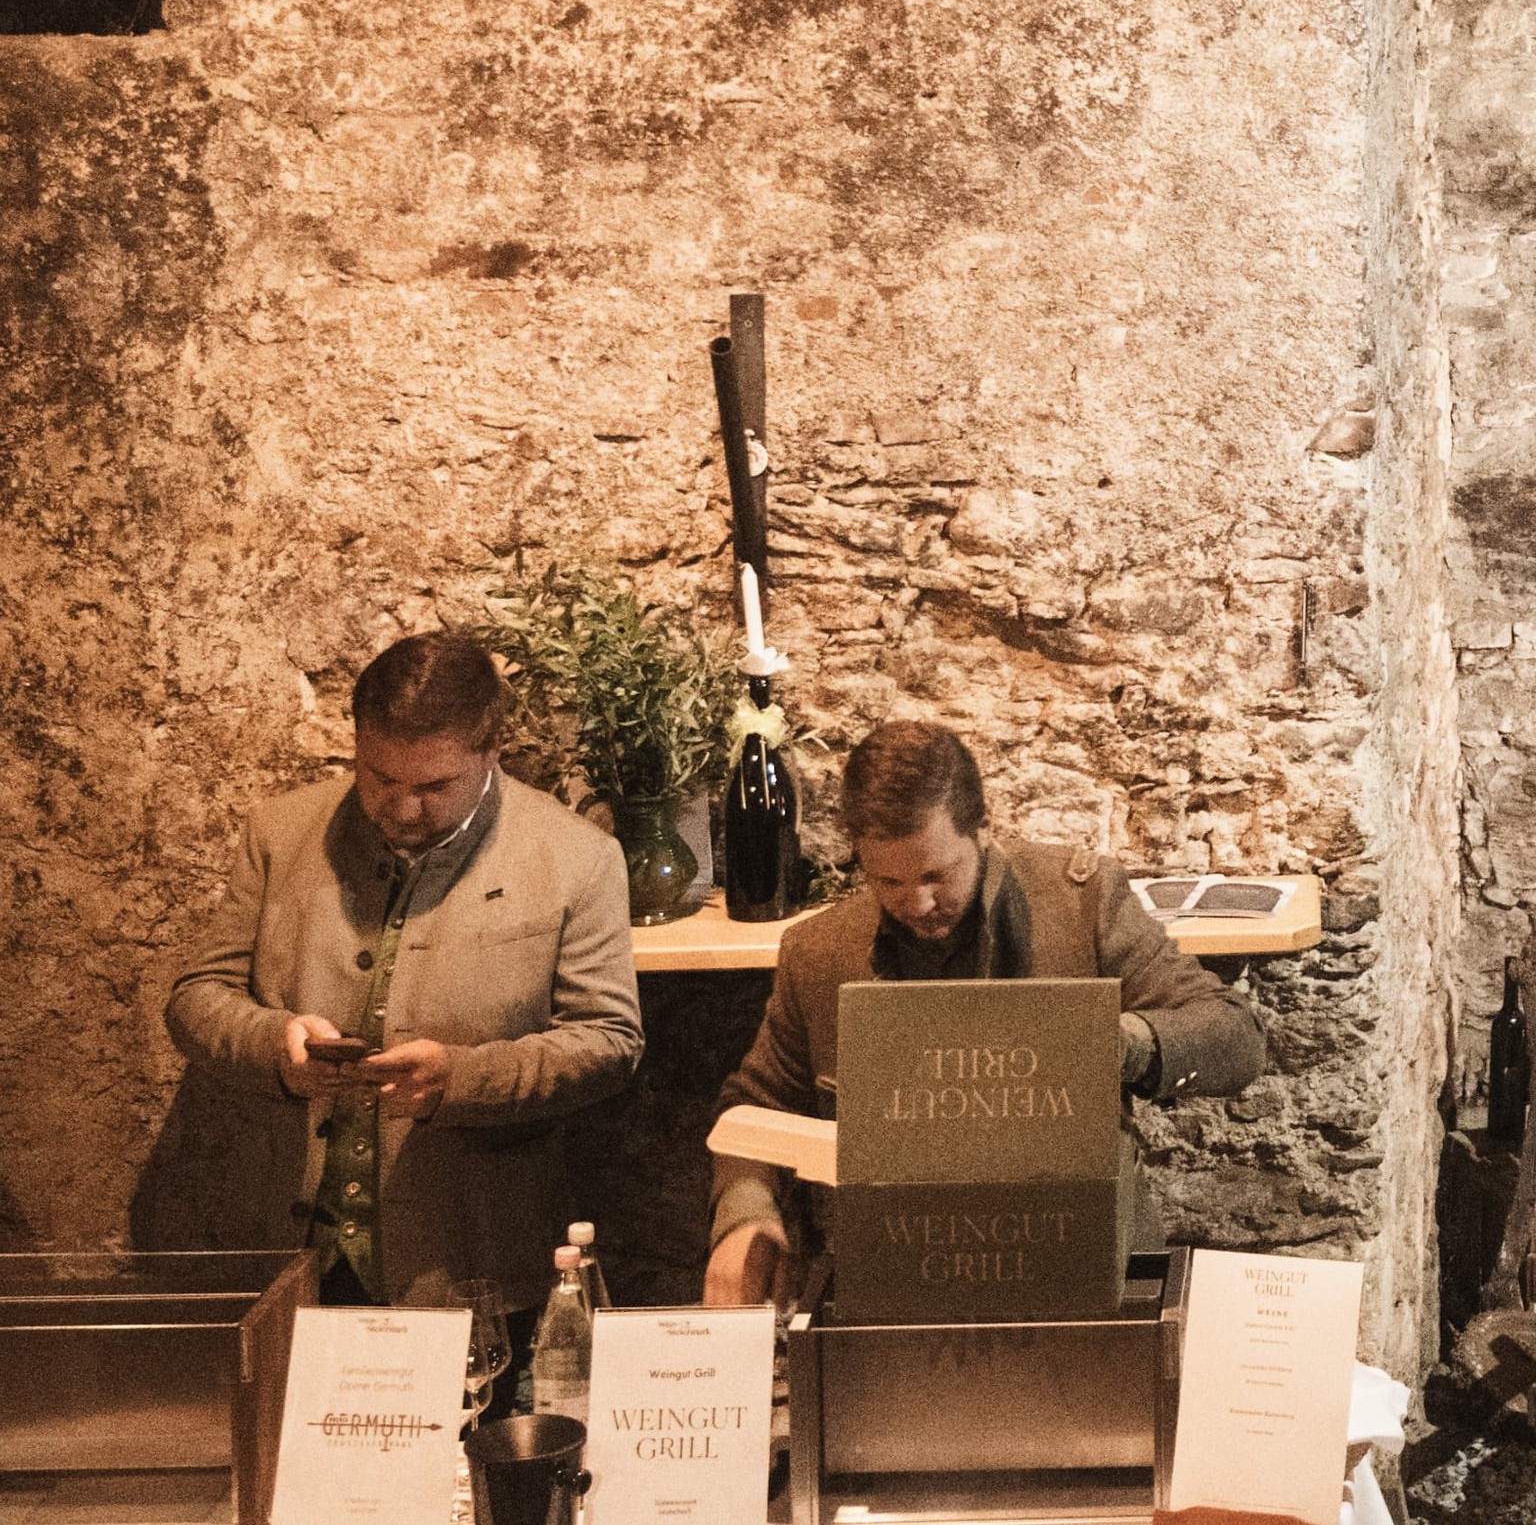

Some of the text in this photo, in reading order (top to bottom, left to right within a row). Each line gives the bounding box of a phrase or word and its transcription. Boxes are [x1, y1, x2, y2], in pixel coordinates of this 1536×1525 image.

[924, 1046, 1039, 1079] GRILL
[884, 1086, 1075, 1120] WEINGUT
[884, 1212, 1075, 1245] WEINGUT
[921, 1250, 1032, 1282] GRILL
[1244, 1267, 1309, 1285] WEINGUT
[1254, 1284, 1296, 1298] GRILL
[649, 1368, 716, 1381] Weingut Grill
[322, 1412, 423, 1439] GERMUTH
[612, 1407, 748, 1431] WEINGUT
[635, 1437, 719, 1460] GRILL
